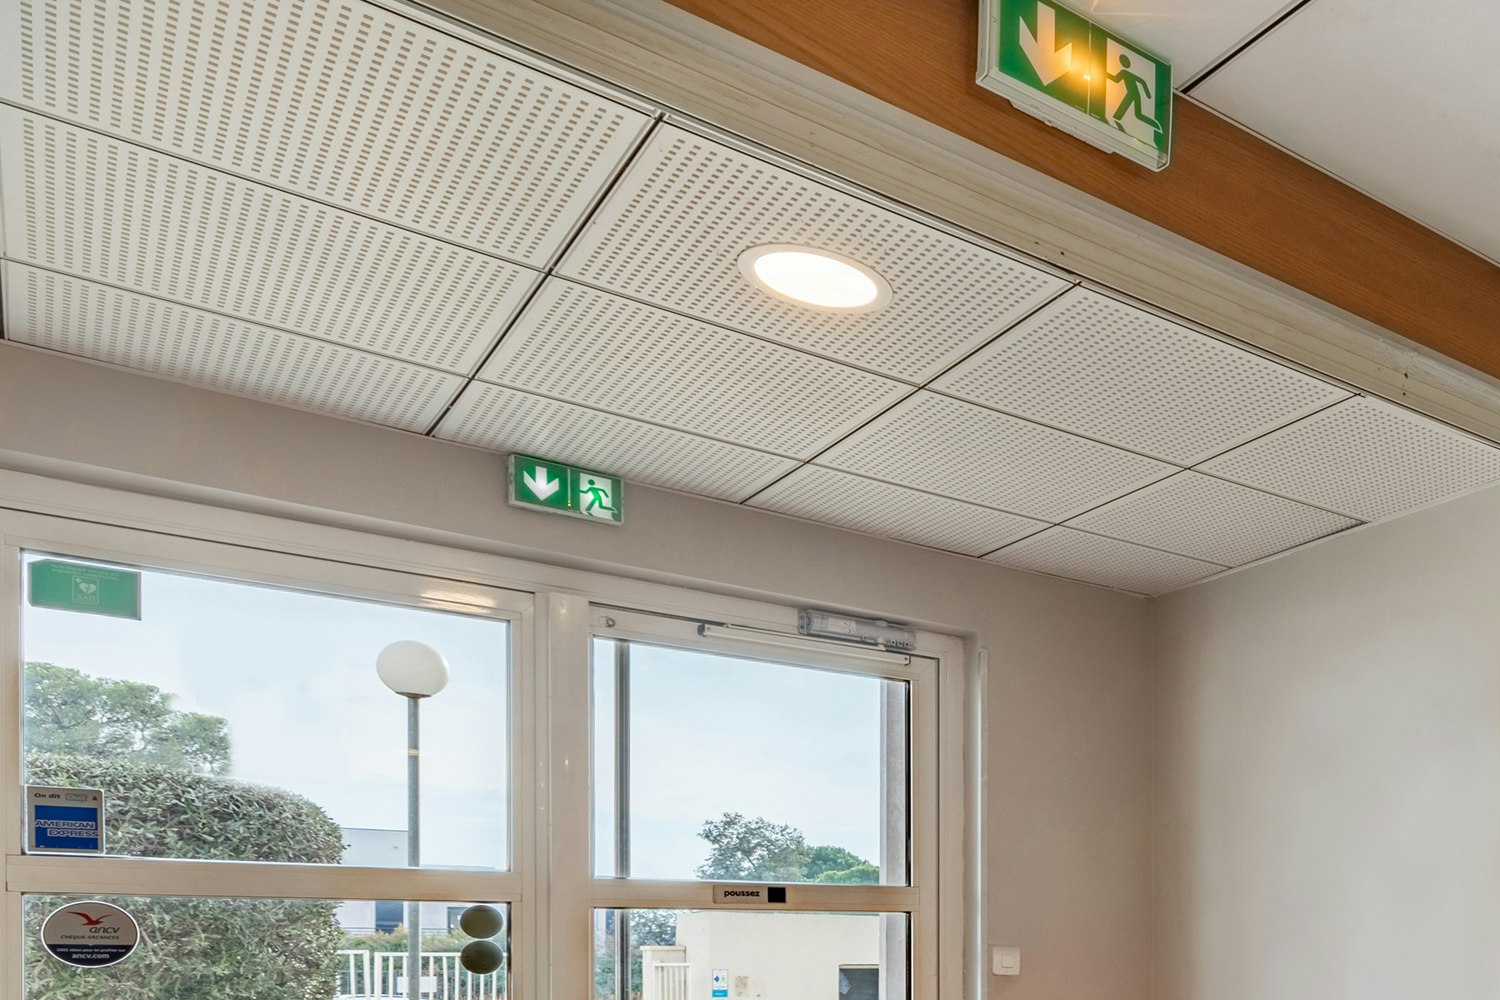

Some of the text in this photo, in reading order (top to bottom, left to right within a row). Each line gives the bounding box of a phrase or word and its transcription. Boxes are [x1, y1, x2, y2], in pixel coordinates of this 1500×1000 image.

[35, 819, 96, 829] AMERICAN
[47, 829, 99, 838] EXPRESS
[724, 890, 760, 898] poussez
[89, 926, 120, 934] ancv
